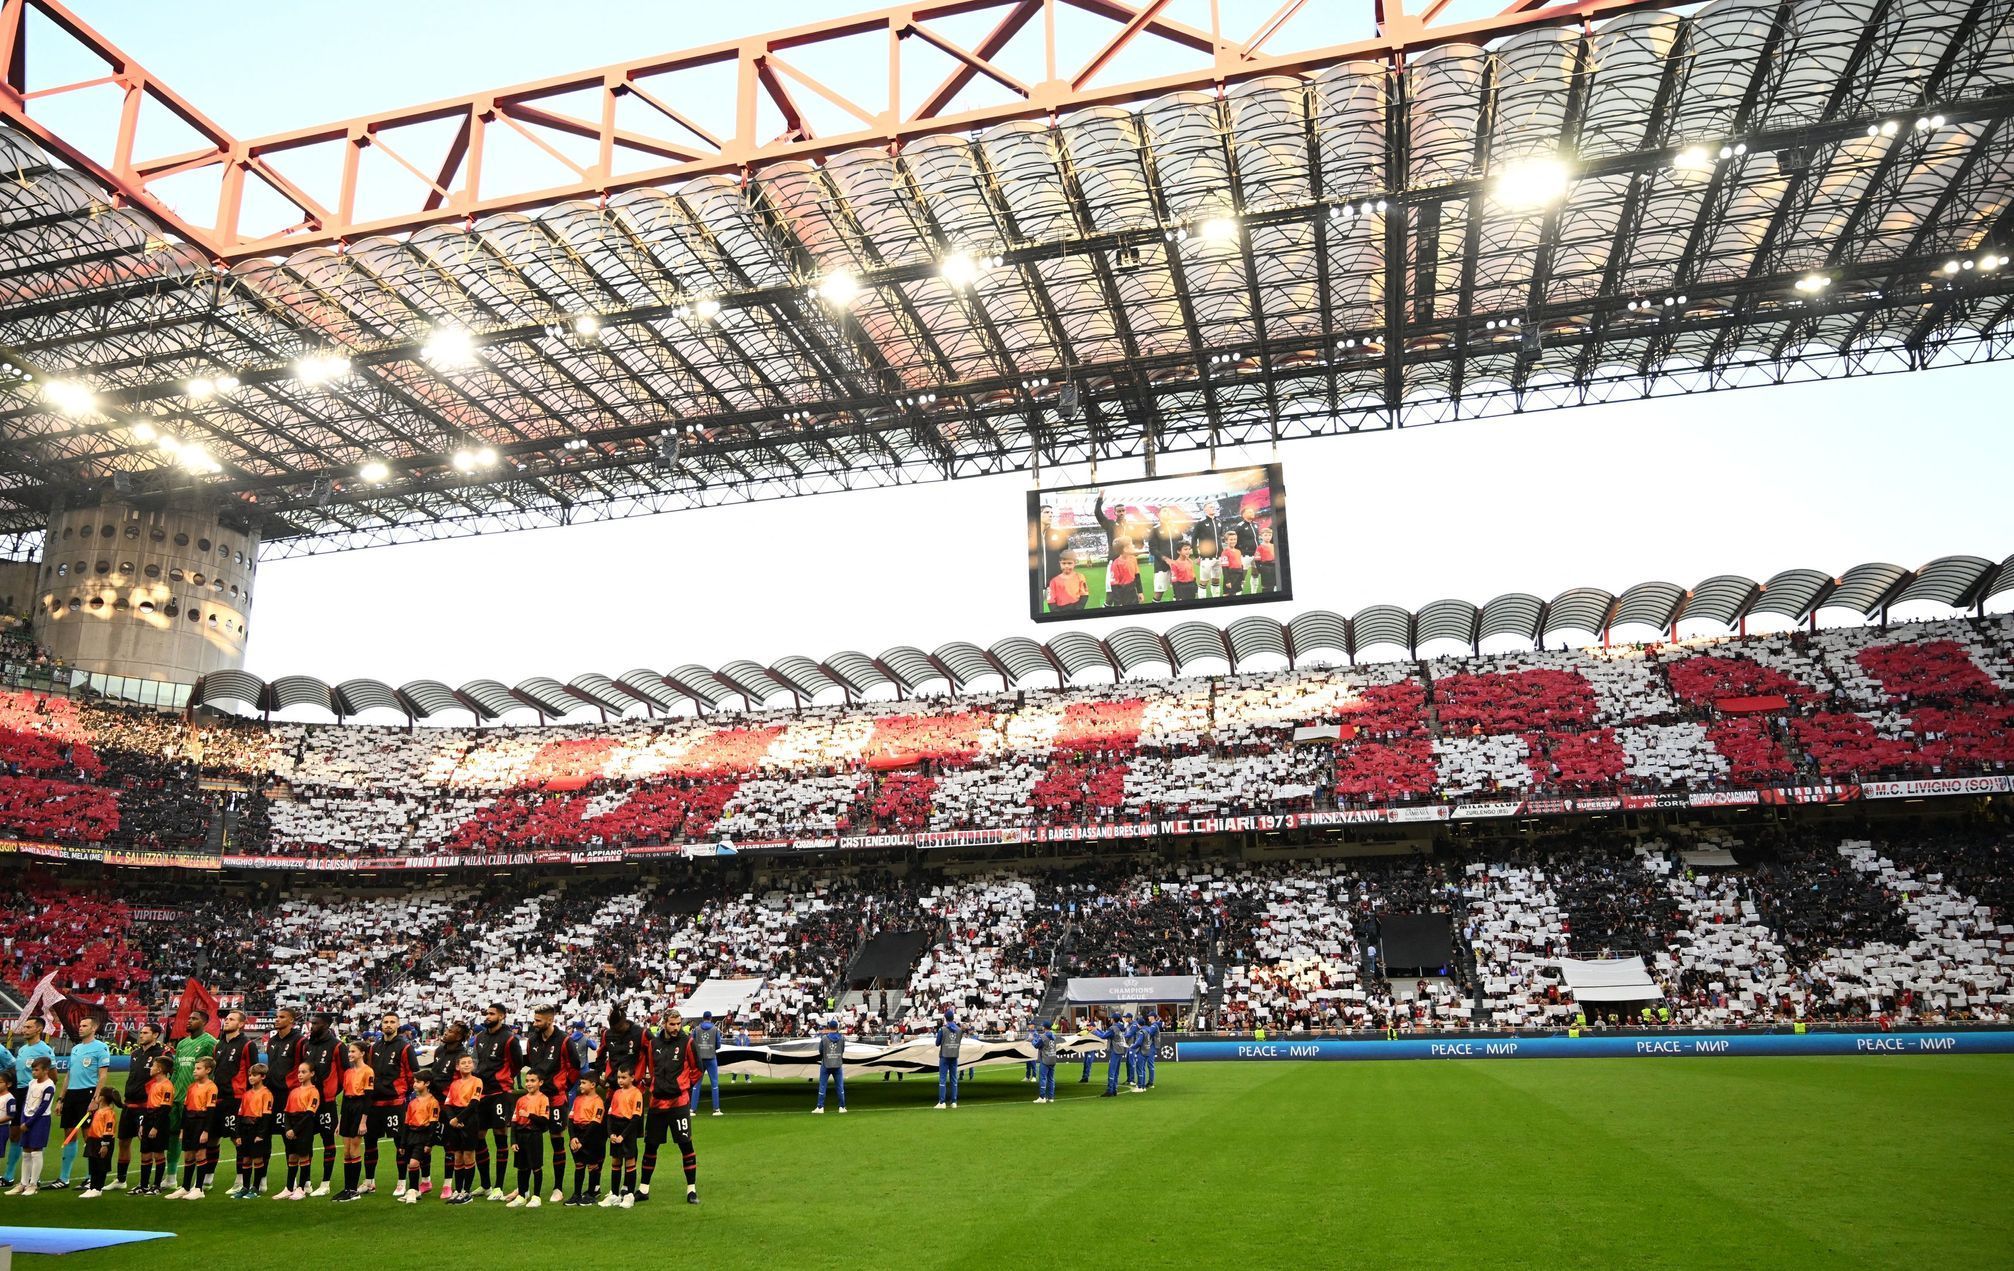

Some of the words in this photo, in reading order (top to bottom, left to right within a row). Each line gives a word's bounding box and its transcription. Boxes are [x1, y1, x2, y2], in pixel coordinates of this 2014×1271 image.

[1907, 781, 1961, 793] LIVIGNO
[1964, 779, 1993, 792] (SO)
[1689, 793, 1714, 806] GRUPPO
[1726, 791, 1759, 804] CAGNACCI
[1798, 794, 1824, 802] 1967
[1576, 801, 1621, 809] SUPERSTAR
[1259, 815, 1294, 828] 1973
[1310, 809, 1379, 825] DESENZANO
[1048, 828, 1076, 839] BARESI
[1077, 825, 1112, 838] BASSANO
[1114, 823, 1157, 835] BRESCIANO
[916, 830, 1003, 847] CASTELFIDARDO
[20, 846, 41, 854] SANTA
[41, 848, 59, 857] LUCIA
[60, 851, 70, 859] DEL
[125, 852, 162, 865] SALUZZO
[325, 859, 358, 870] GIUSSANO
[405, 857, 434, 868] MONDO
[436, 856, 460, 867] MILAN
[464, 855, 486, 866] MILAN
[488, 854, 508, 865] CLUB
[509, 853, 533, 865] LATINA
[133, 910, 176, 921] VIPITENO
[1431, 1044, 1473, 1055] PEACE
[1637, 1041, 1681, 1053] PEACE
[1857, 1038, 1905, 1050] PEACE
[1238, 1046, 1277, 1057] PEACE
[496, 1103, 503, 1115] 8
[553, 1108, 560, 1120] 9
[224, 1115, 236, 1127] 32
[319, 1112, 332, 1125] 23
[387, 1115, 399, 1127] 33
[676, 1118, 689, 1131] 19
